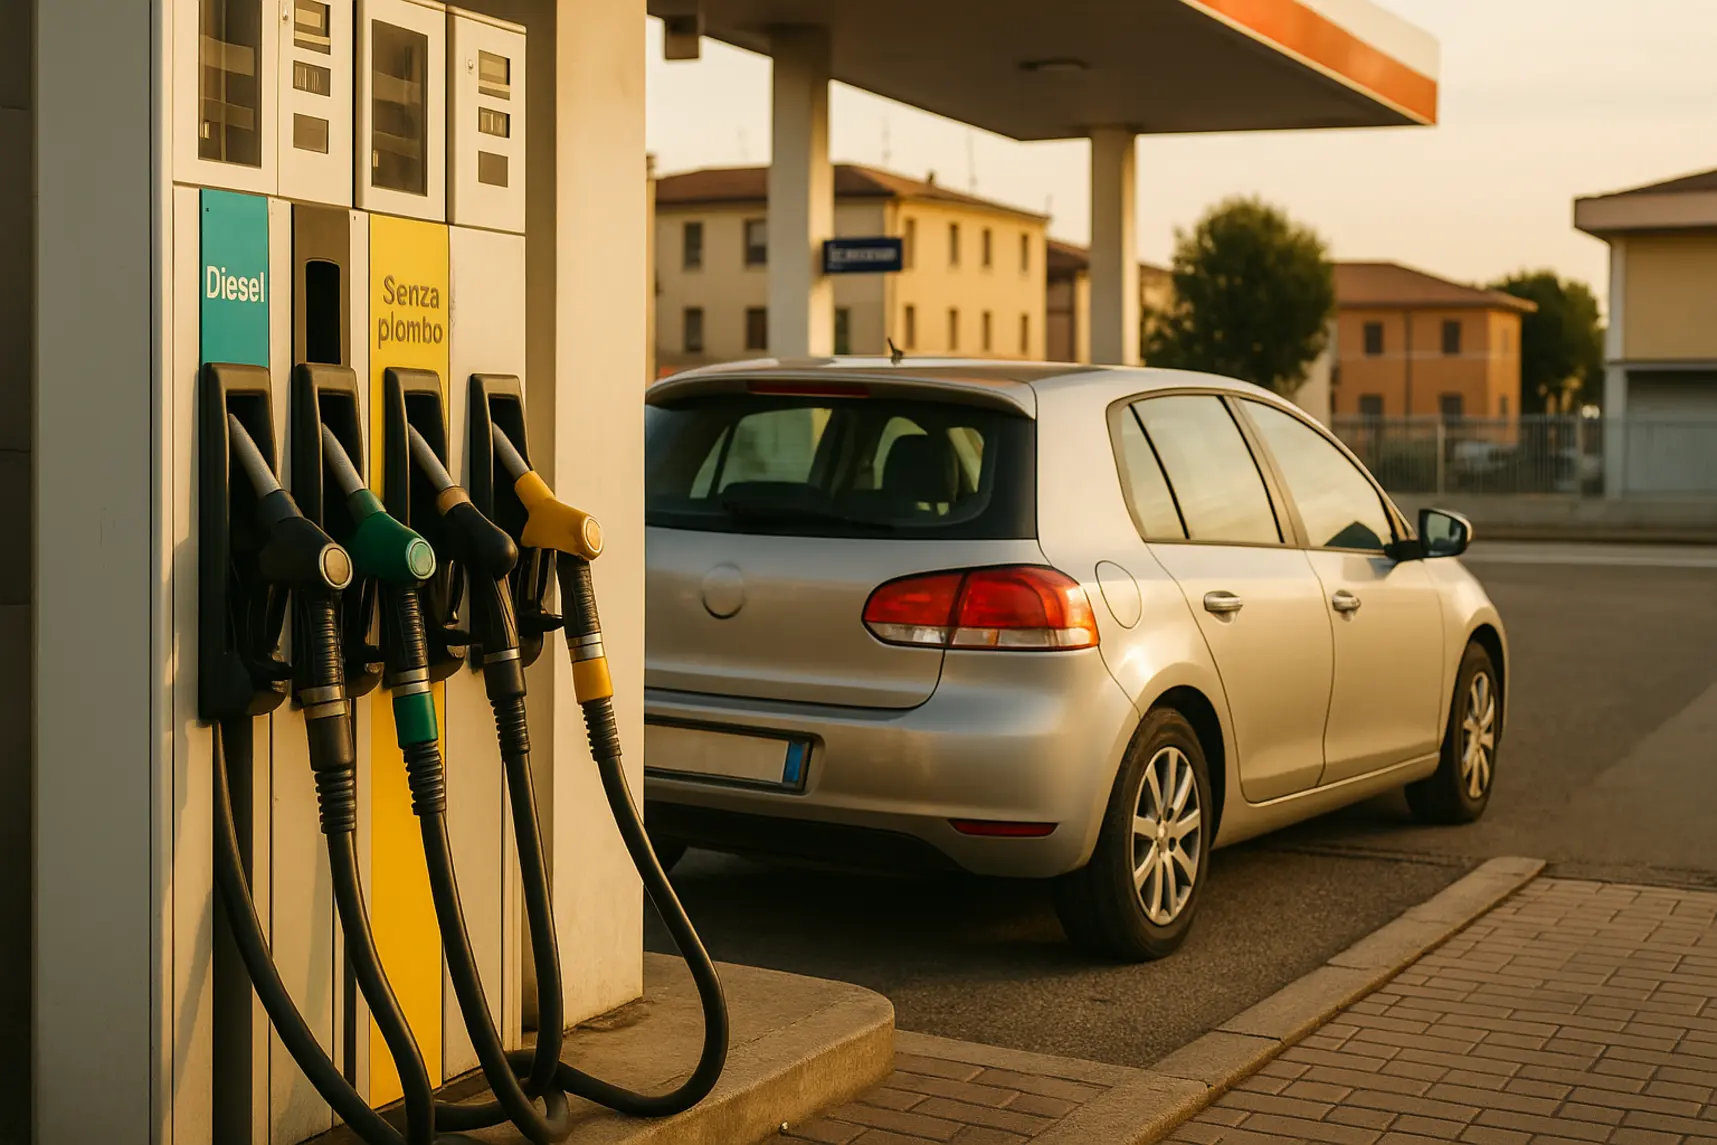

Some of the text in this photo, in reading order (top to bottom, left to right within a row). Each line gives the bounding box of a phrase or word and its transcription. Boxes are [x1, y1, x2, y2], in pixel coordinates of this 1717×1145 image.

[206, 265, 265, 302] Diesel
[383, 275, 440, 309] Senza
[378, 311, 443, 349] plombo
